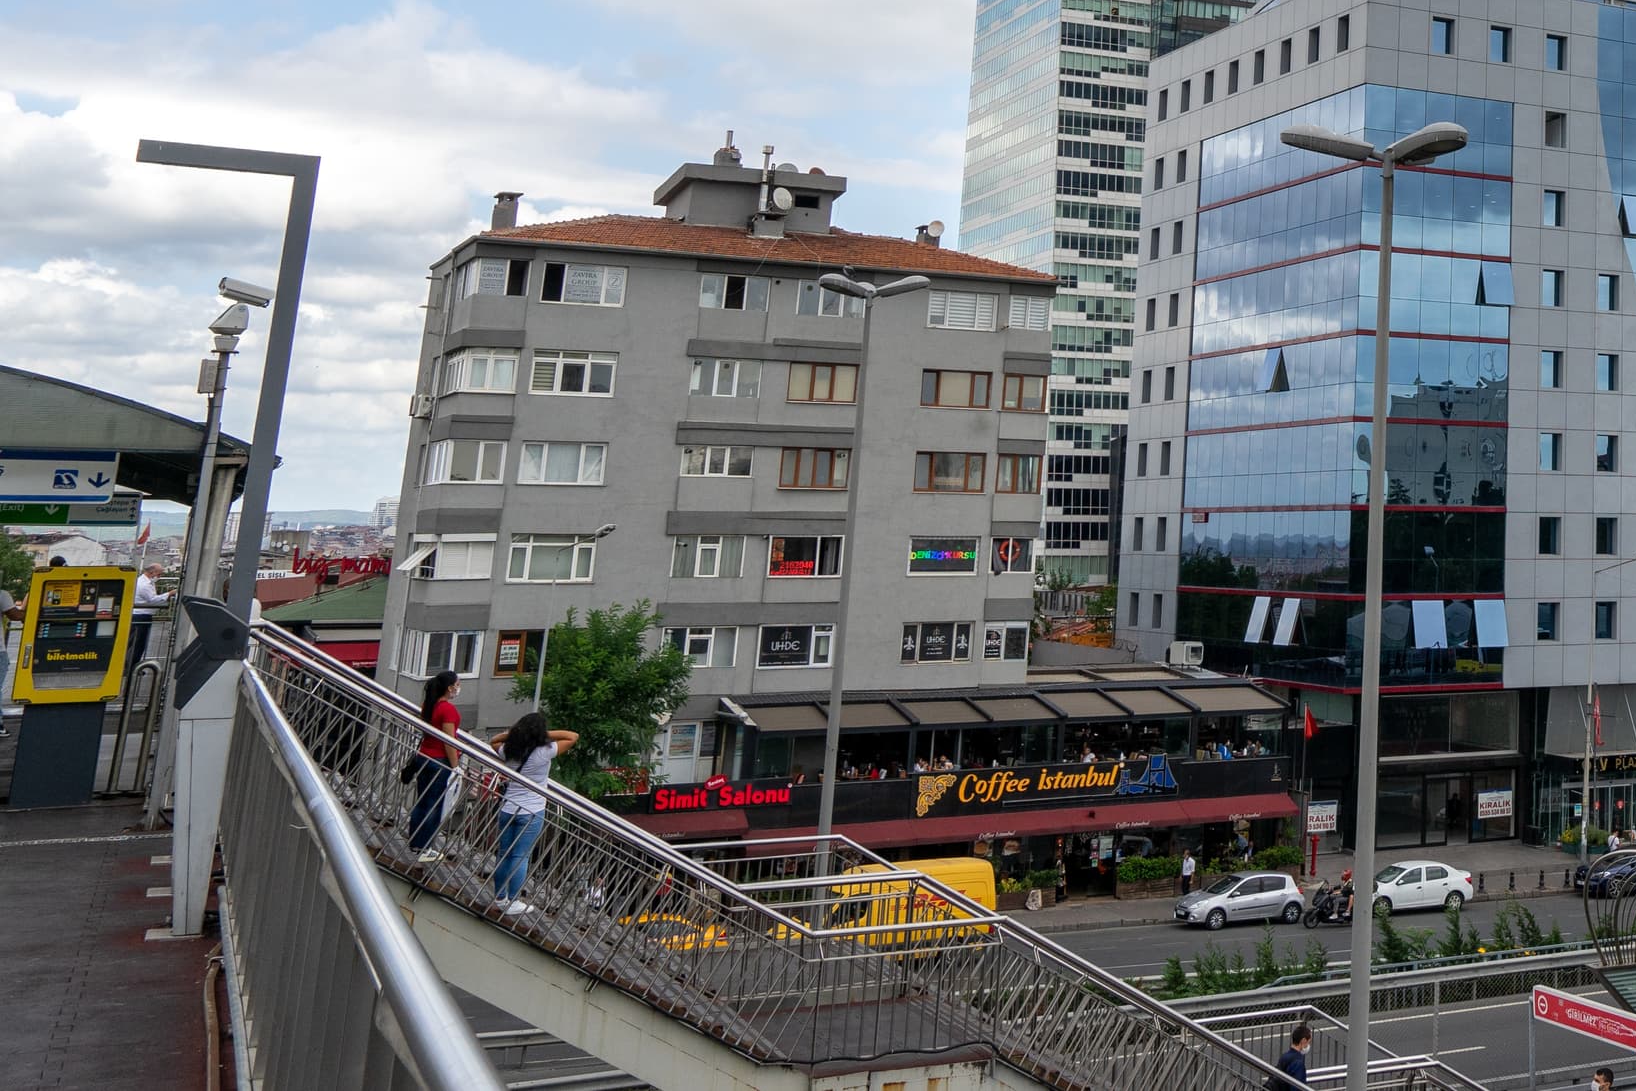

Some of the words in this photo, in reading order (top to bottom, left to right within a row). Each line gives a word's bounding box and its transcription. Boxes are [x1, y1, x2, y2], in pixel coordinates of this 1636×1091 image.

[571, 278, 598, 286] GROUP
[46, 650, 98, 661] biletmatik
[958, 771, 1031, 803] Coffee
[655, 788, 708, 810] Simit
[719, 783, 790, 807] Salonu
[1308, 813, 1335, 823] RALIK
